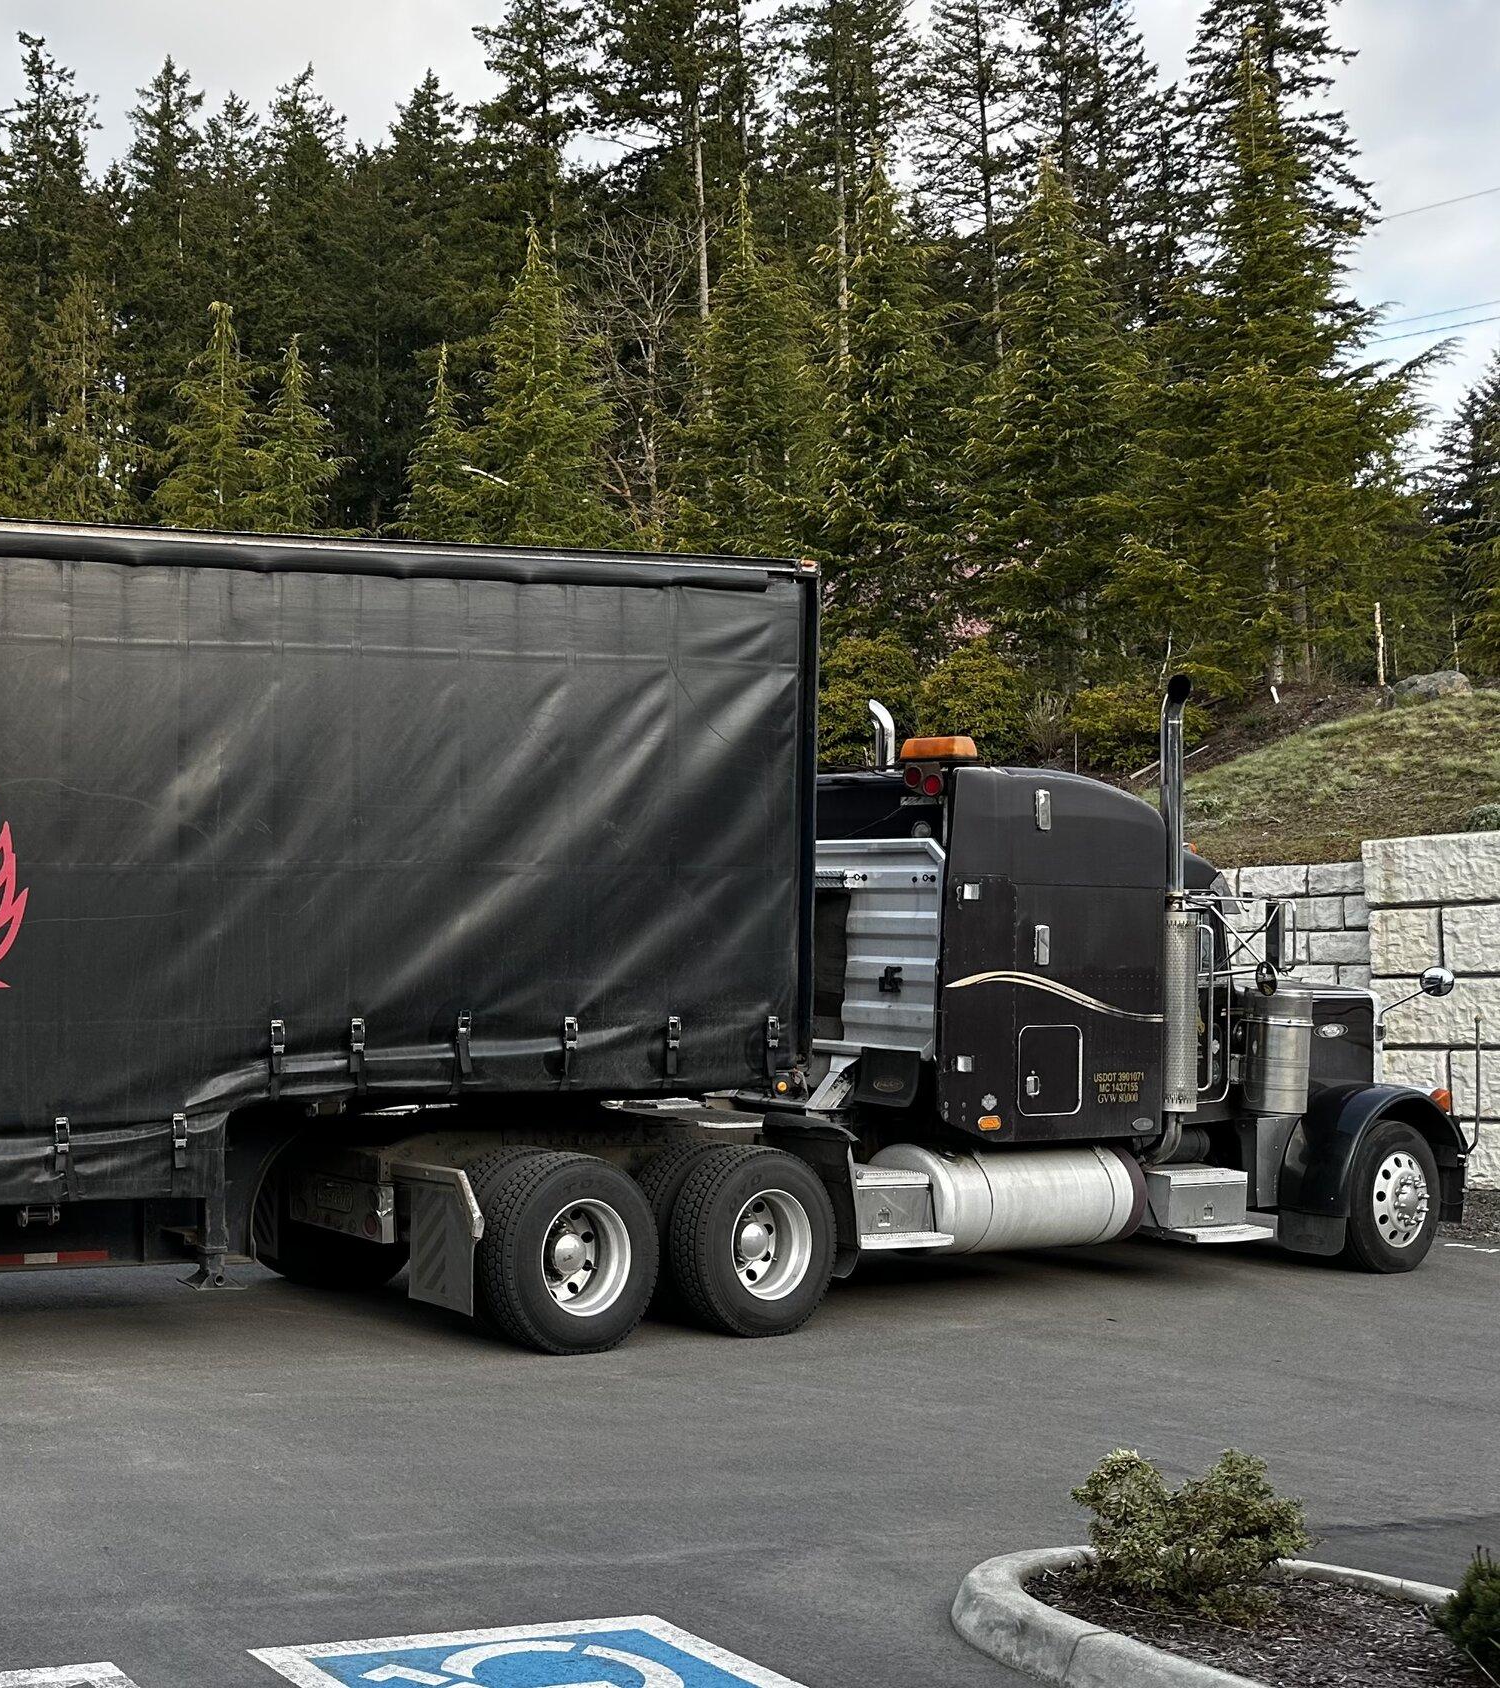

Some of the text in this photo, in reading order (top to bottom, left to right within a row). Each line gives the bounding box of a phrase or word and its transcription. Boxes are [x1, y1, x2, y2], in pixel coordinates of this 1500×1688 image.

[1093, 1072, 1117, 1083] USDOT
[1099, 1083, 1111, 1092] MC
[1097, 1093, 1117, 1104] GVW
